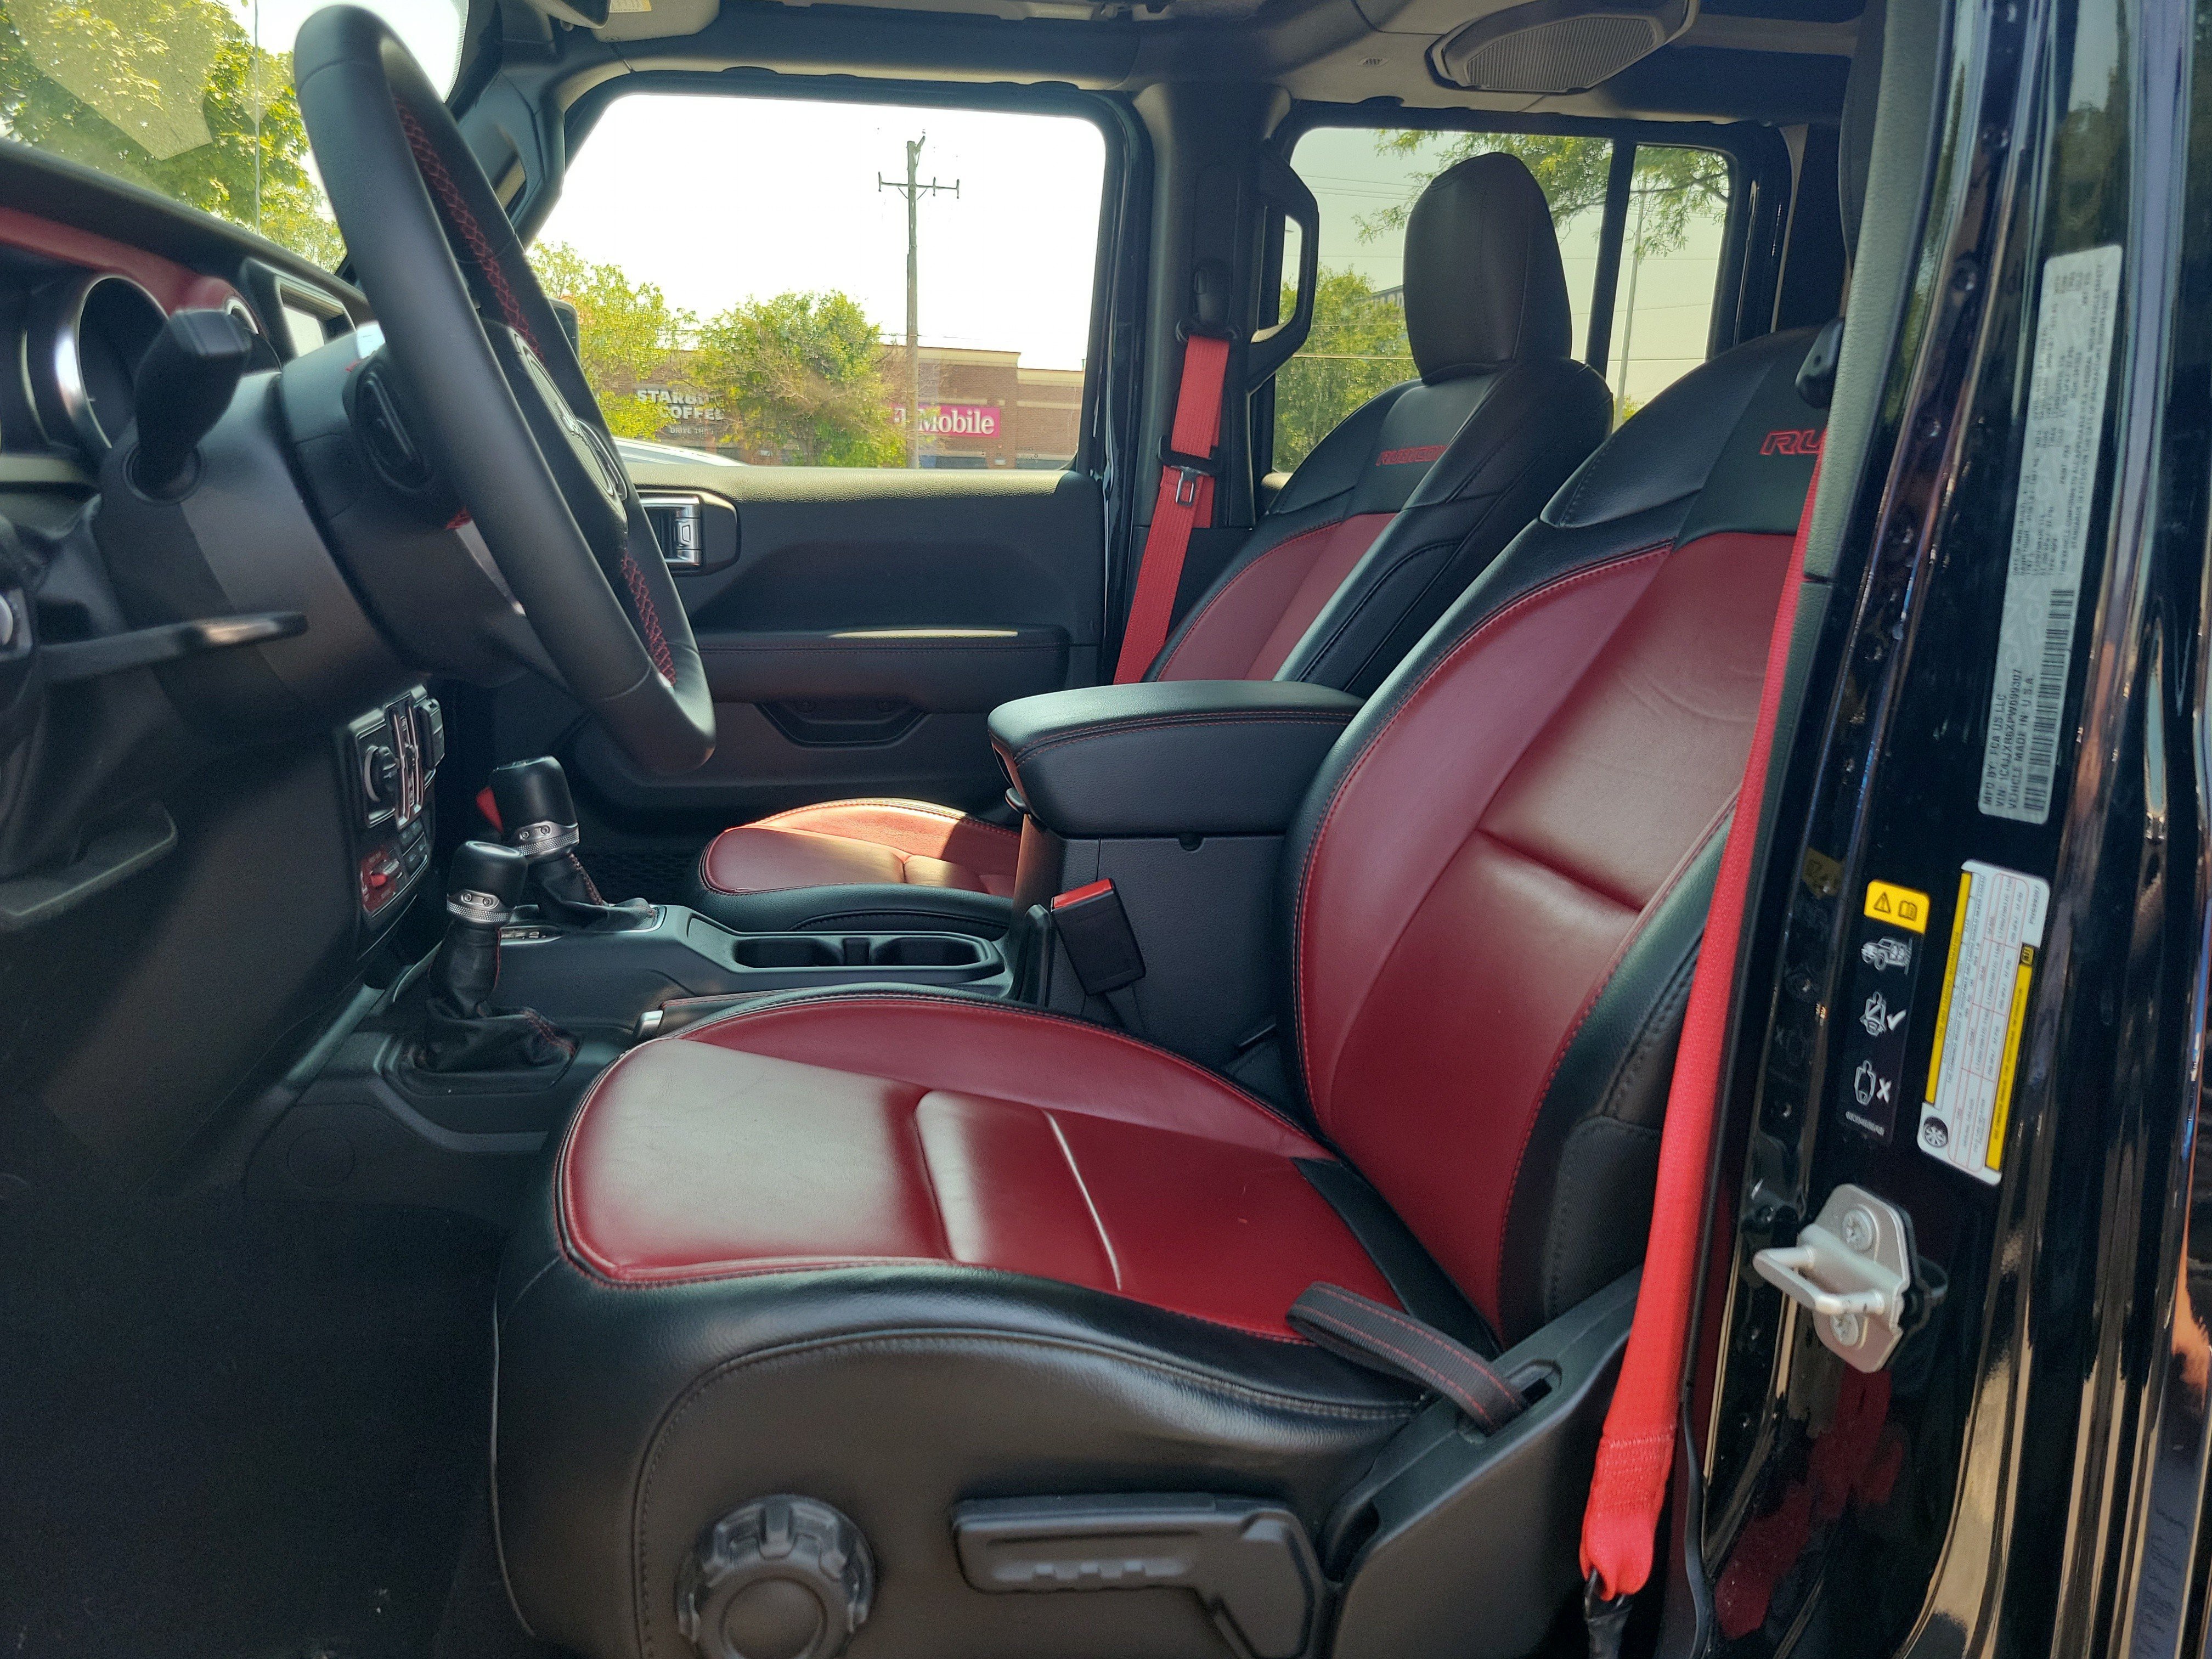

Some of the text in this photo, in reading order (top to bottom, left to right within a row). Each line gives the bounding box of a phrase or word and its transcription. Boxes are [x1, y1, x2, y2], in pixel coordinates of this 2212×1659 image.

[1993, 693, 2006, 713] LLC
[1991, 716, 2003, 731] US
[2012, 730, 2027, 763] MADE
[1982, 782, 1995, 805] MFD
[2007, 766, 2023, 810] VEHICLE
